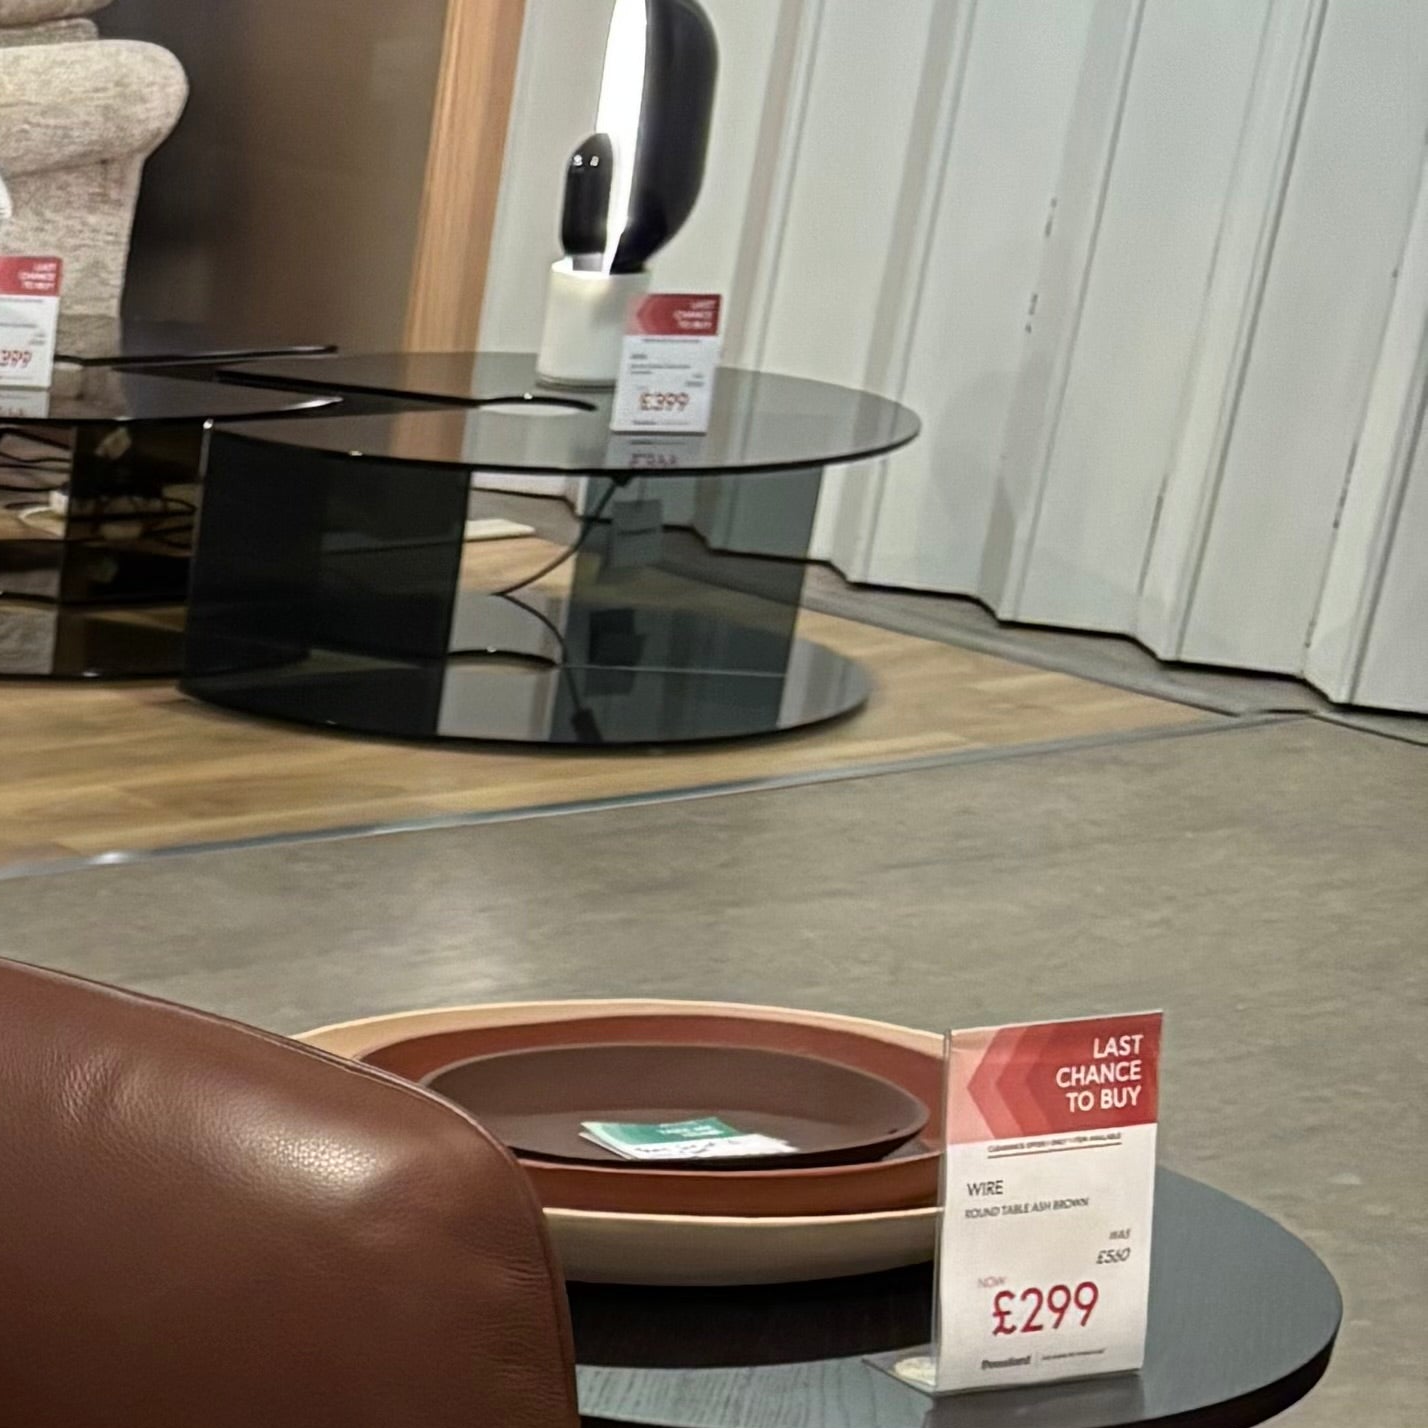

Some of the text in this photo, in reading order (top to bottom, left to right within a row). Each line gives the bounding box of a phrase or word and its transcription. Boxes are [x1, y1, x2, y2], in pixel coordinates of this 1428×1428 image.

[1093, 1034, 1144, 1059] LAST
[1056, 1060, 1142, 1088] CHANCE
[1066, 1085, 1142, 1112] TO BUY
[967, 1180, 1004, 1197] WIRE
[965, 1197, 1090, 1219] ROUND TABLE ASH BROWN
[977, 1276, 1006, 1288] NOW
[992, 1281, 1099, 1336] £299
